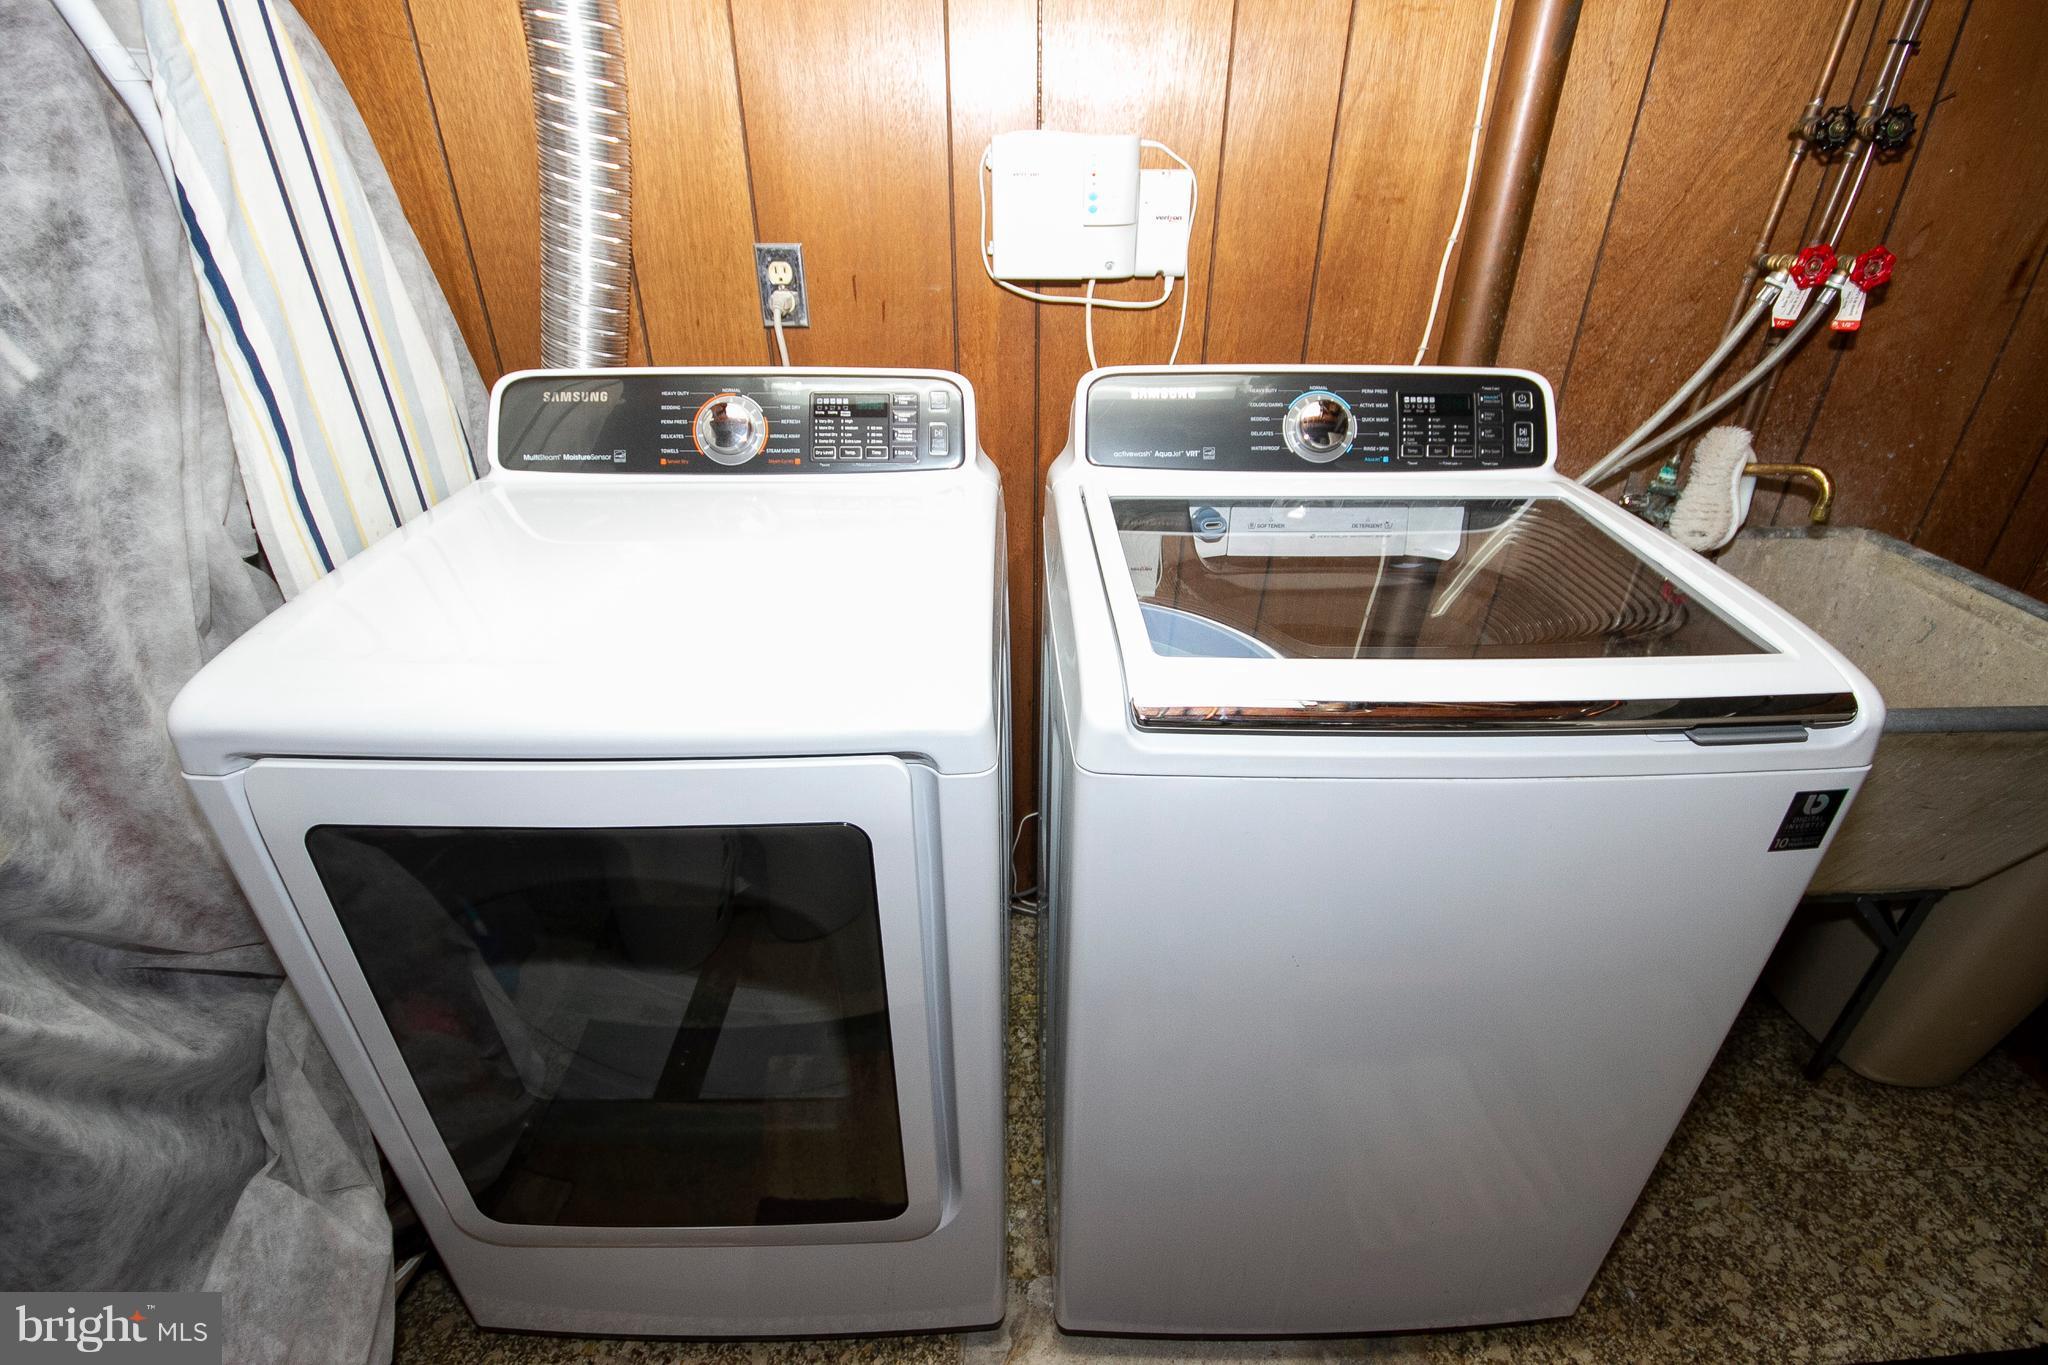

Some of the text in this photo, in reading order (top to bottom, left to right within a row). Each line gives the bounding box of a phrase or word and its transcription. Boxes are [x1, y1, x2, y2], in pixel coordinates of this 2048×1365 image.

[1155, 215, 1183, 223] verizon
[543, 391, 608, 402] SAMSUNG
[562, 453, 612, 461] MoistureSensor
[1774, 837, 1790, 849] 10
